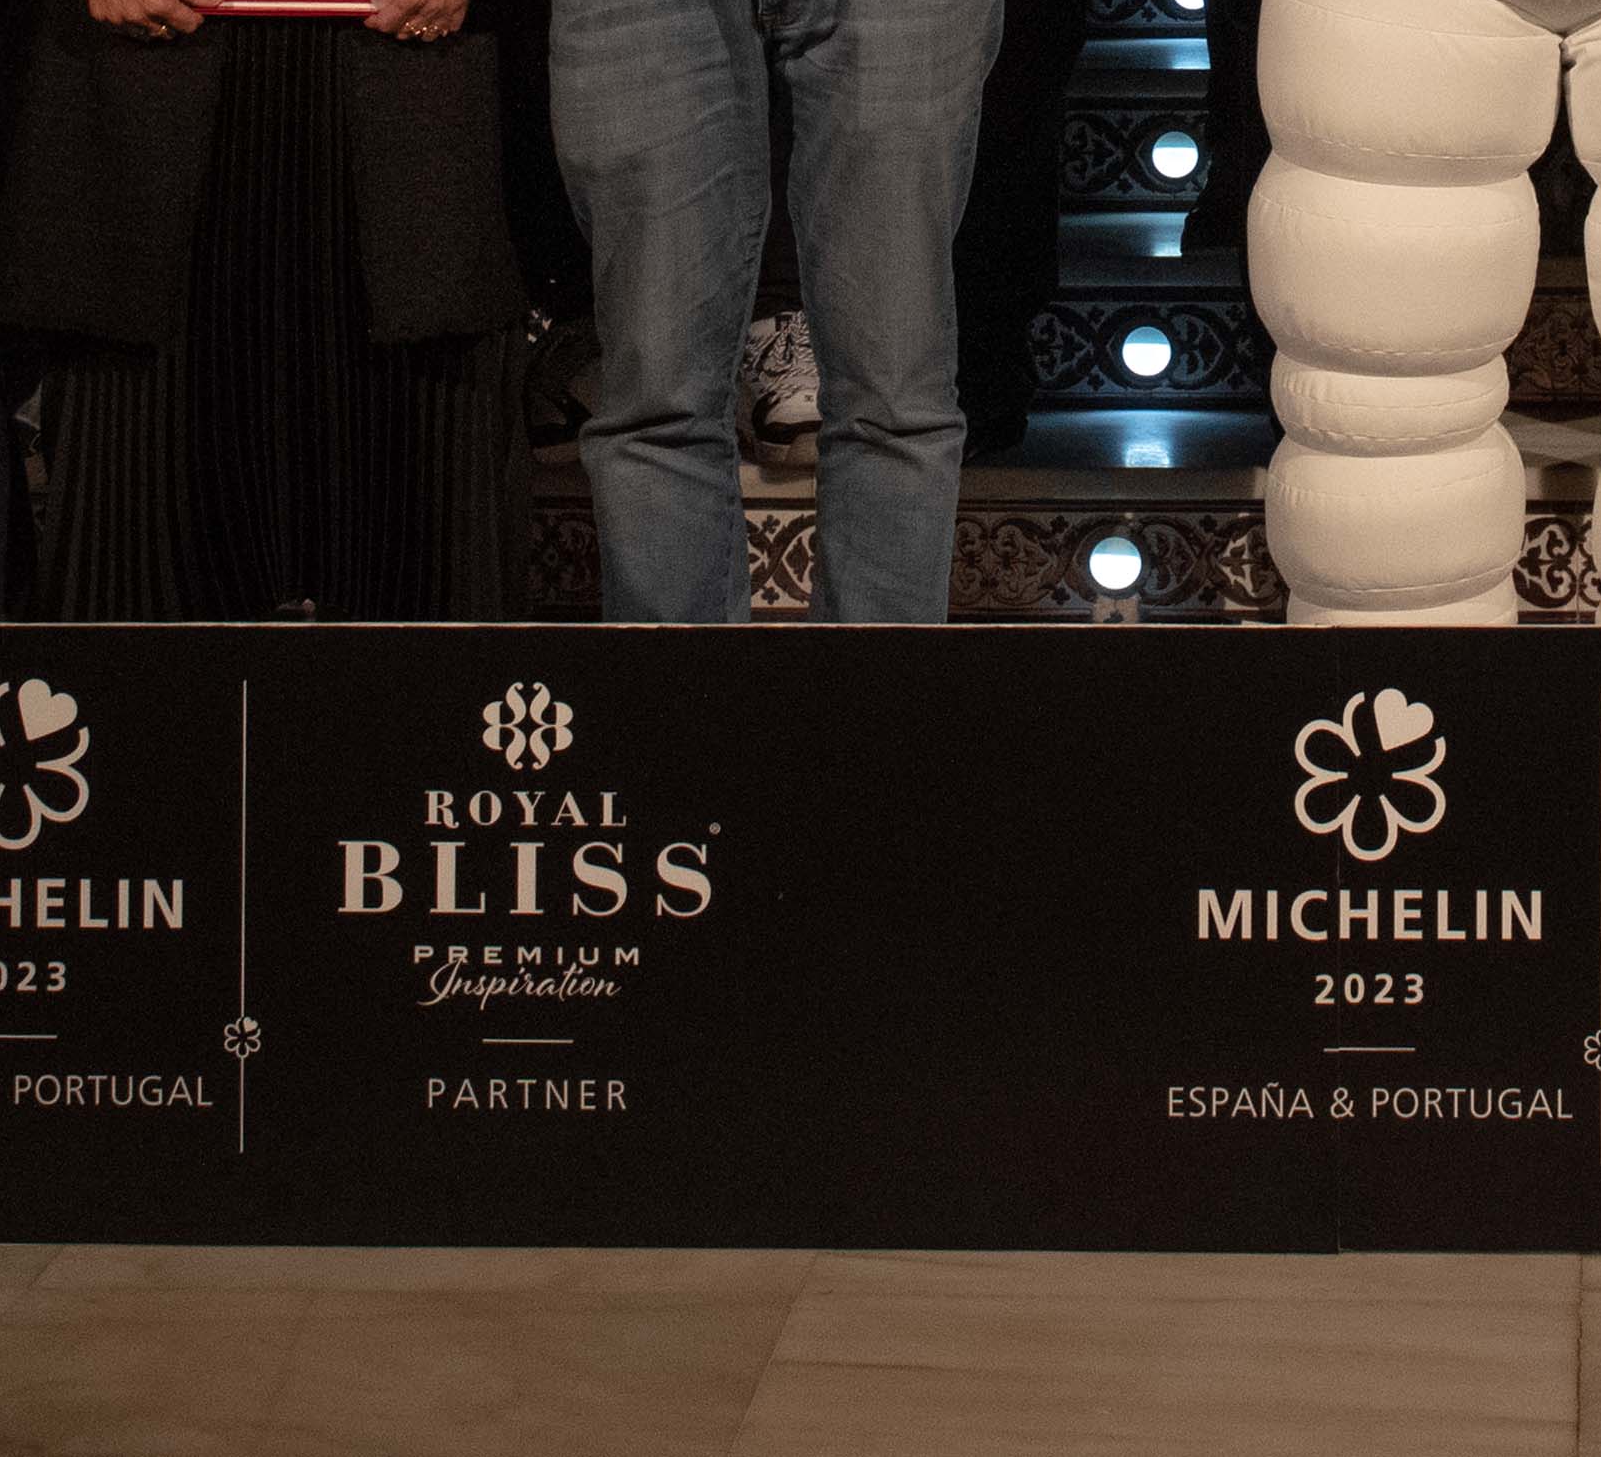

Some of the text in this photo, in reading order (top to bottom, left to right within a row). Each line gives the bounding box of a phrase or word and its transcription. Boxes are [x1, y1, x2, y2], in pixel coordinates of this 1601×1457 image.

[425, 791, 626, 829] ROYAL
[1199, 889, 1541, 941] MICHELIN
[414, 945, 639, 966] PREMIUM
[420, 958, 620, 1010] Inspiration
[1315, 973, 1423, 1004] 2023
[14, 1074, 213, 1106] PORTUGAL
[428, 1078, 626, 1110] PARTNER
[1169, 1082, 1573, 1119] ESPAÑA & PORTUGAL
